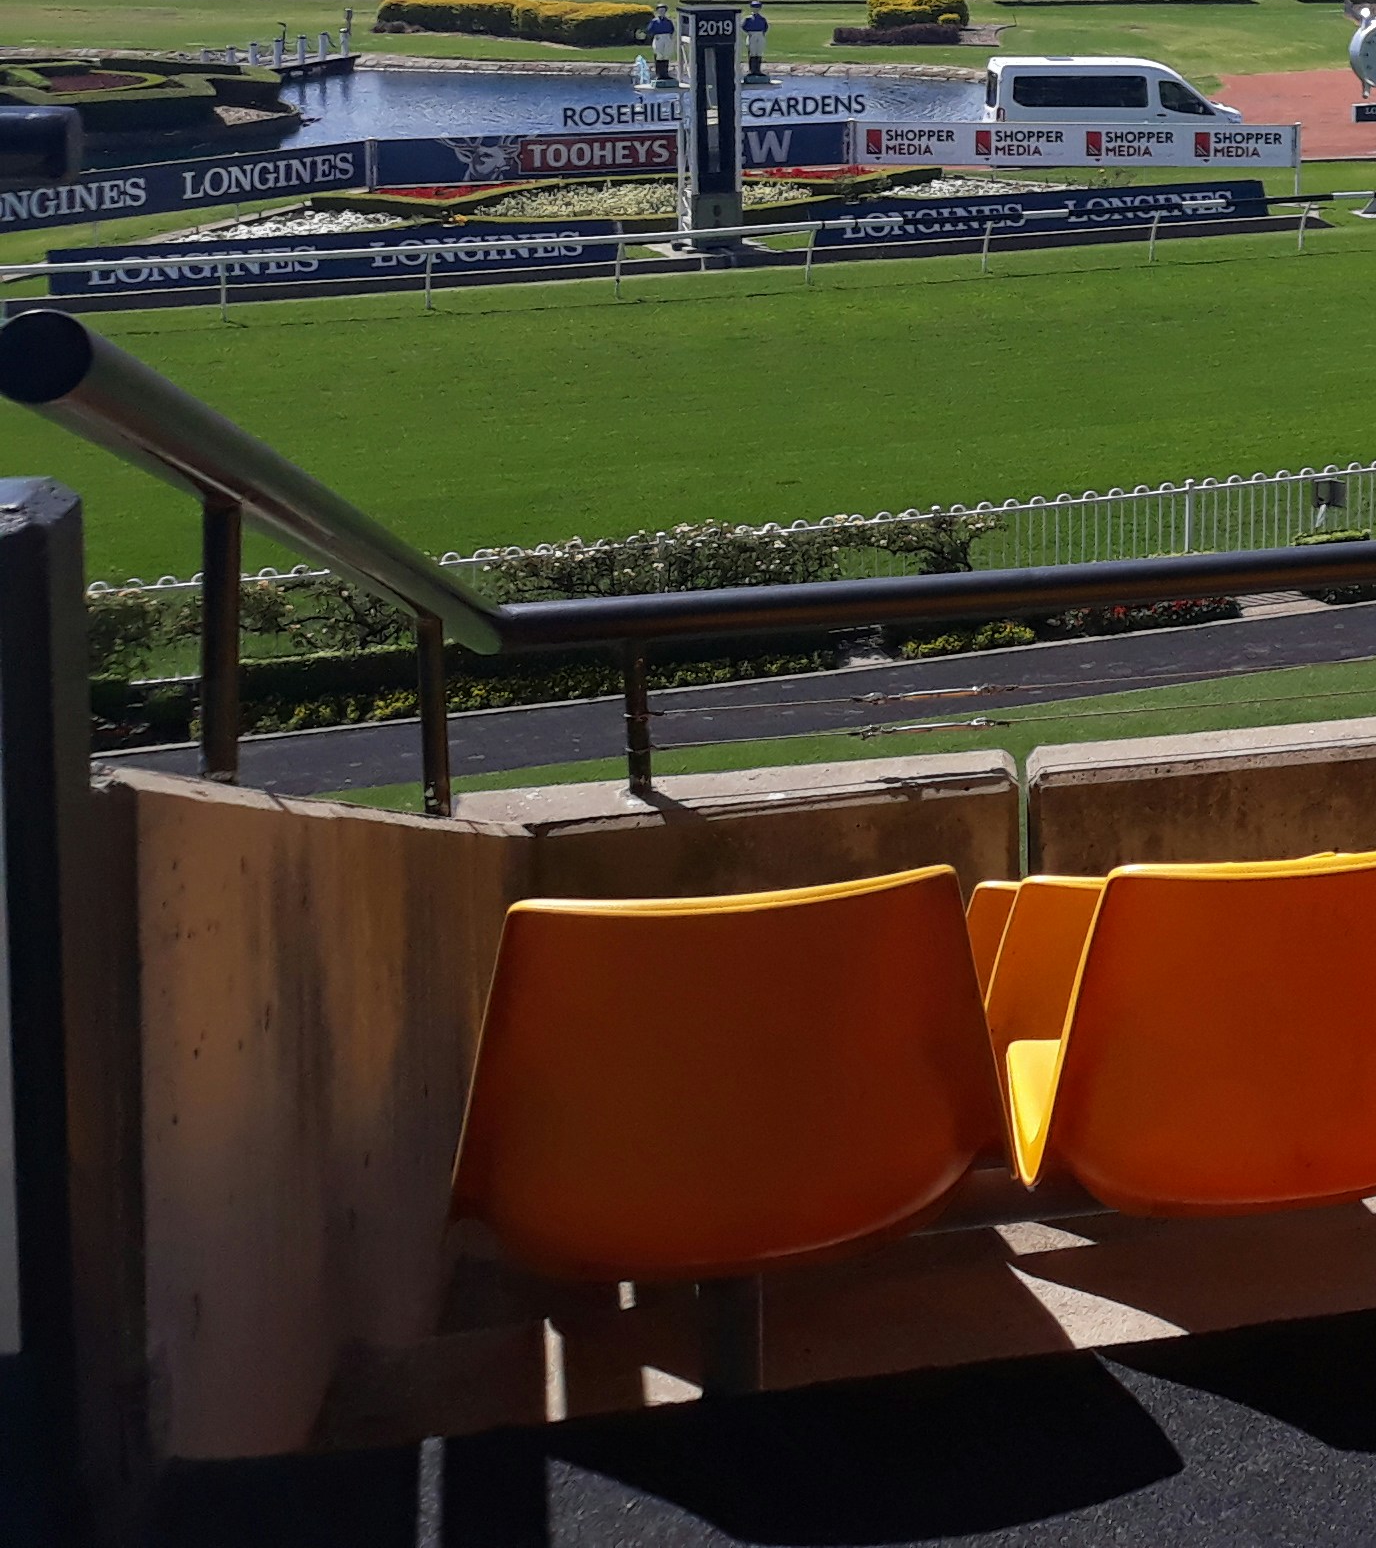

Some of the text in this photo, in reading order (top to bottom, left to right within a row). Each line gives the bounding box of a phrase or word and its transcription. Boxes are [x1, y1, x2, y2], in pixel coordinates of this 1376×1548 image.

[699, 20, 733, 36] 2019
[563, 94, 866, 127] ROSEHILL GARDENS
[885, 129, 956, 143] SHOPPER
[995, 130, 1065, 144] SHOPPER
[1105, 130, 1174, 144] SHOPPER
[1213, 131, 1283, 145] SHOPPER
[526, 139, 670, 169] TOOHEYS
[885, 143, 934, 156] MEDIA
[994, 144, 1043, 157] MEDIA
[1105, 145, 1153, 158] MEDIA
[1213, 145, 1262, 159] MEDIA
[182, 151, 356, 202] LONGINES
[0, 177, 147, 223] NGINES
[1063, 190, 1237, 224] LONGINES
[839, 203, 1027, 240] LONGINES
[369, 230, 584, 269] LONGINES
[87, 245, 320, 287] LONGINES
